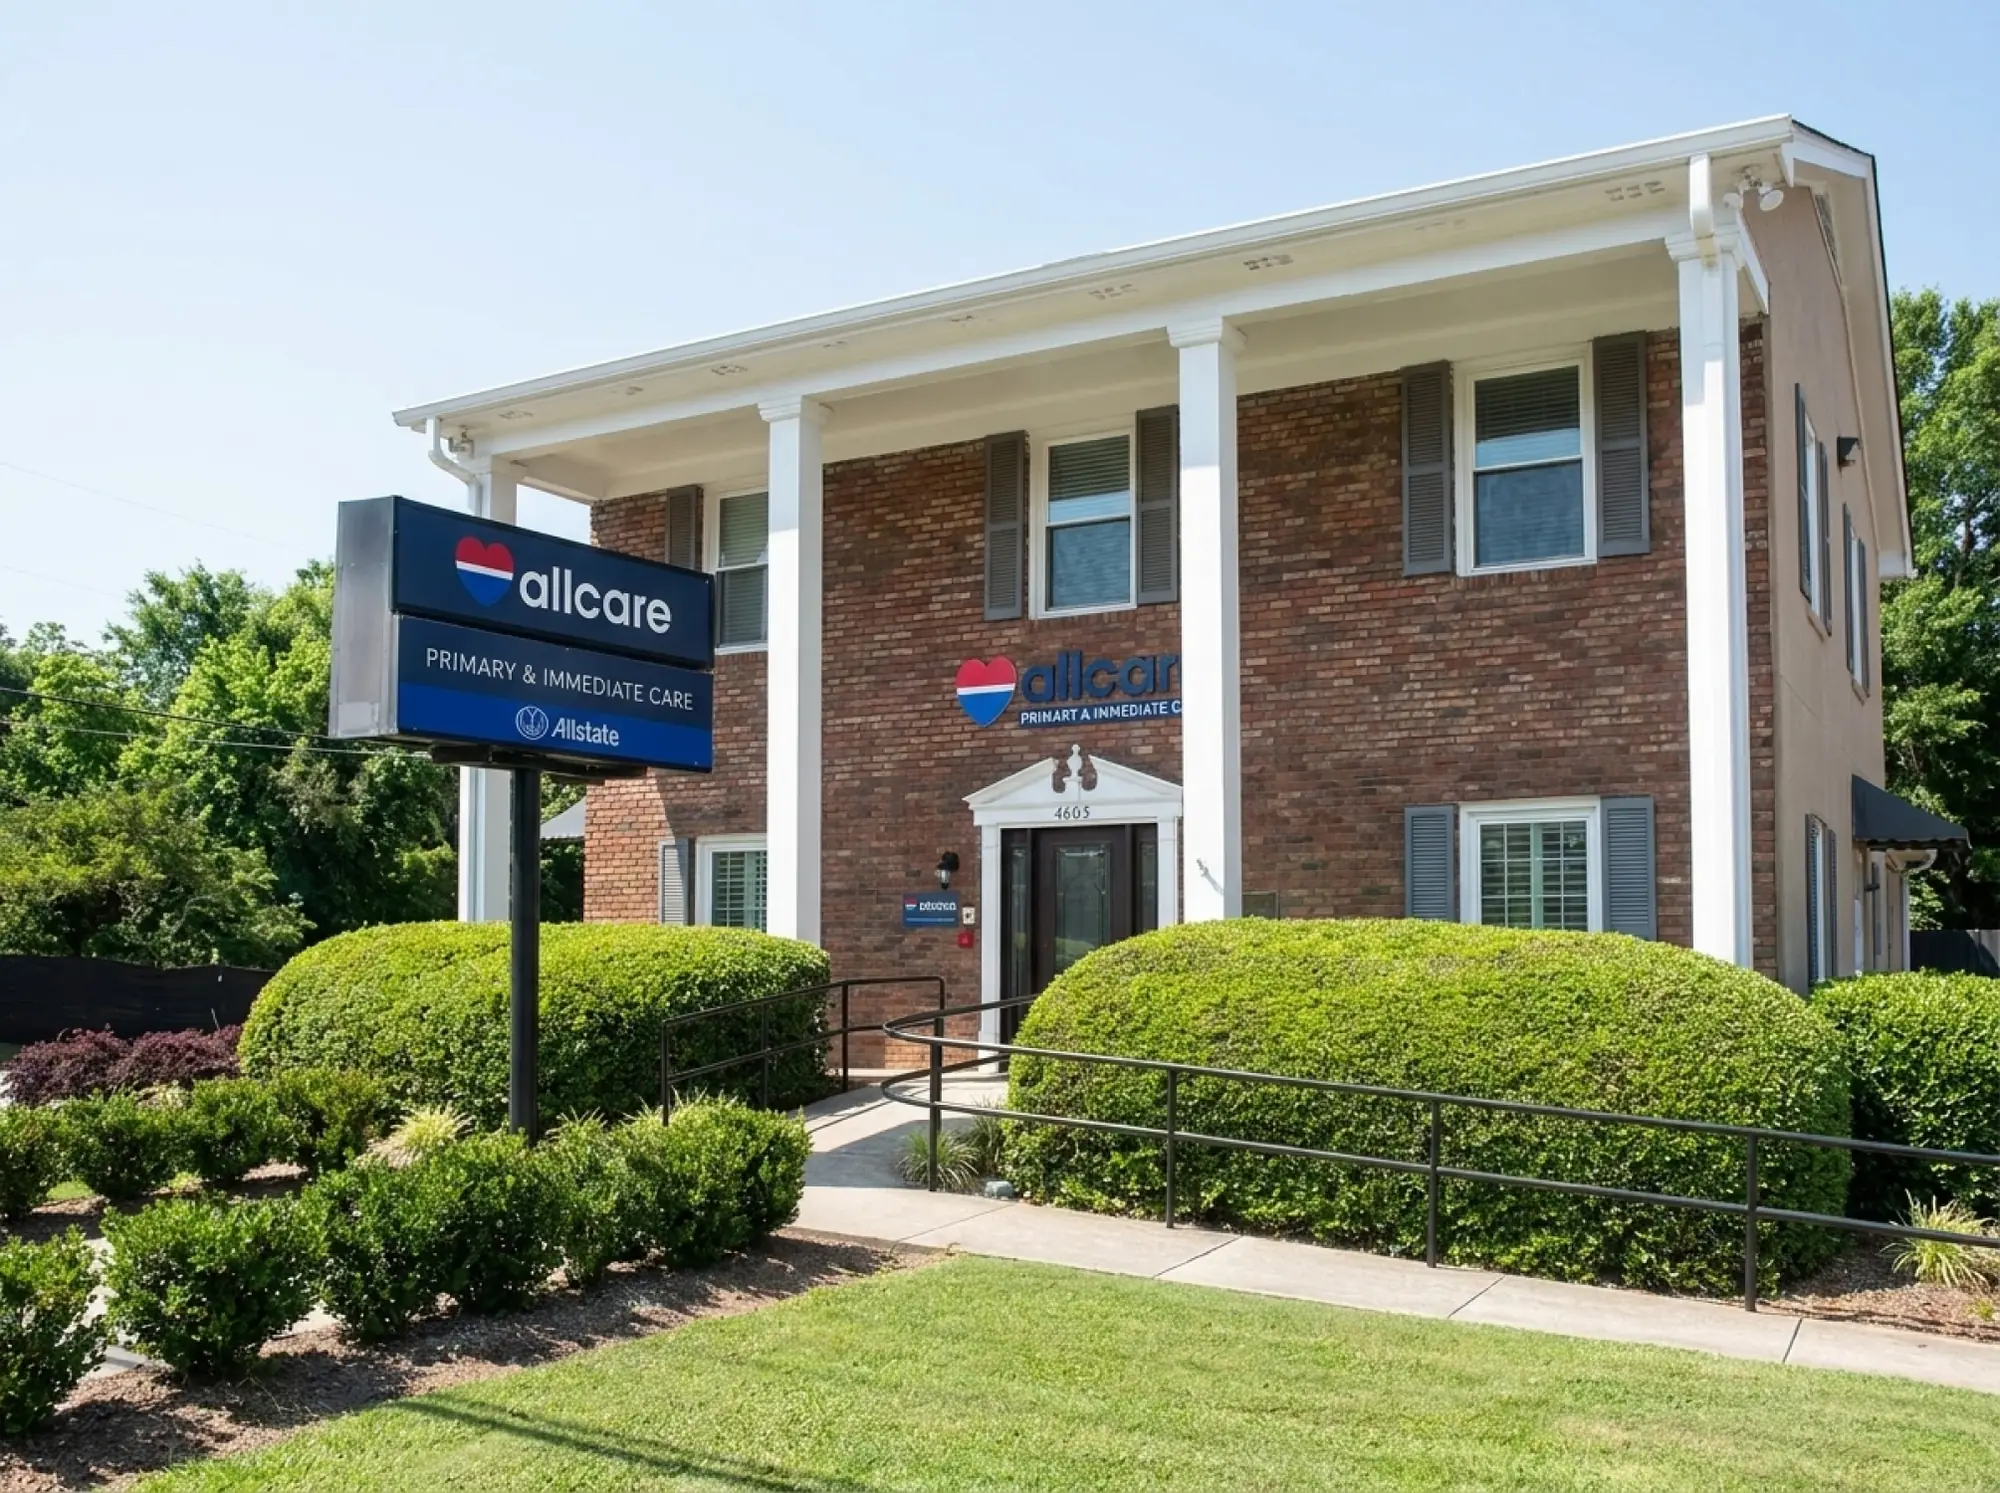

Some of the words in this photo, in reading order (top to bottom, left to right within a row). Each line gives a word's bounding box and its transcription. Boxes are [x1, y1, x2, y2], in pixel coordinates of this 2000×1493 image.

[520, 566, 671, 633] allcare
[427, 648, 517, 680] PRIMARY
[523, 664, 536, 684] &
[543, 668, 644, 702] IMMEDIATE
[649, 687, 693, 710] CARE
[1021, 650, 1179, 702] allcar
[551, 718, 620, 747] Allstate
[1054, 805, 1090, 820] 4605
